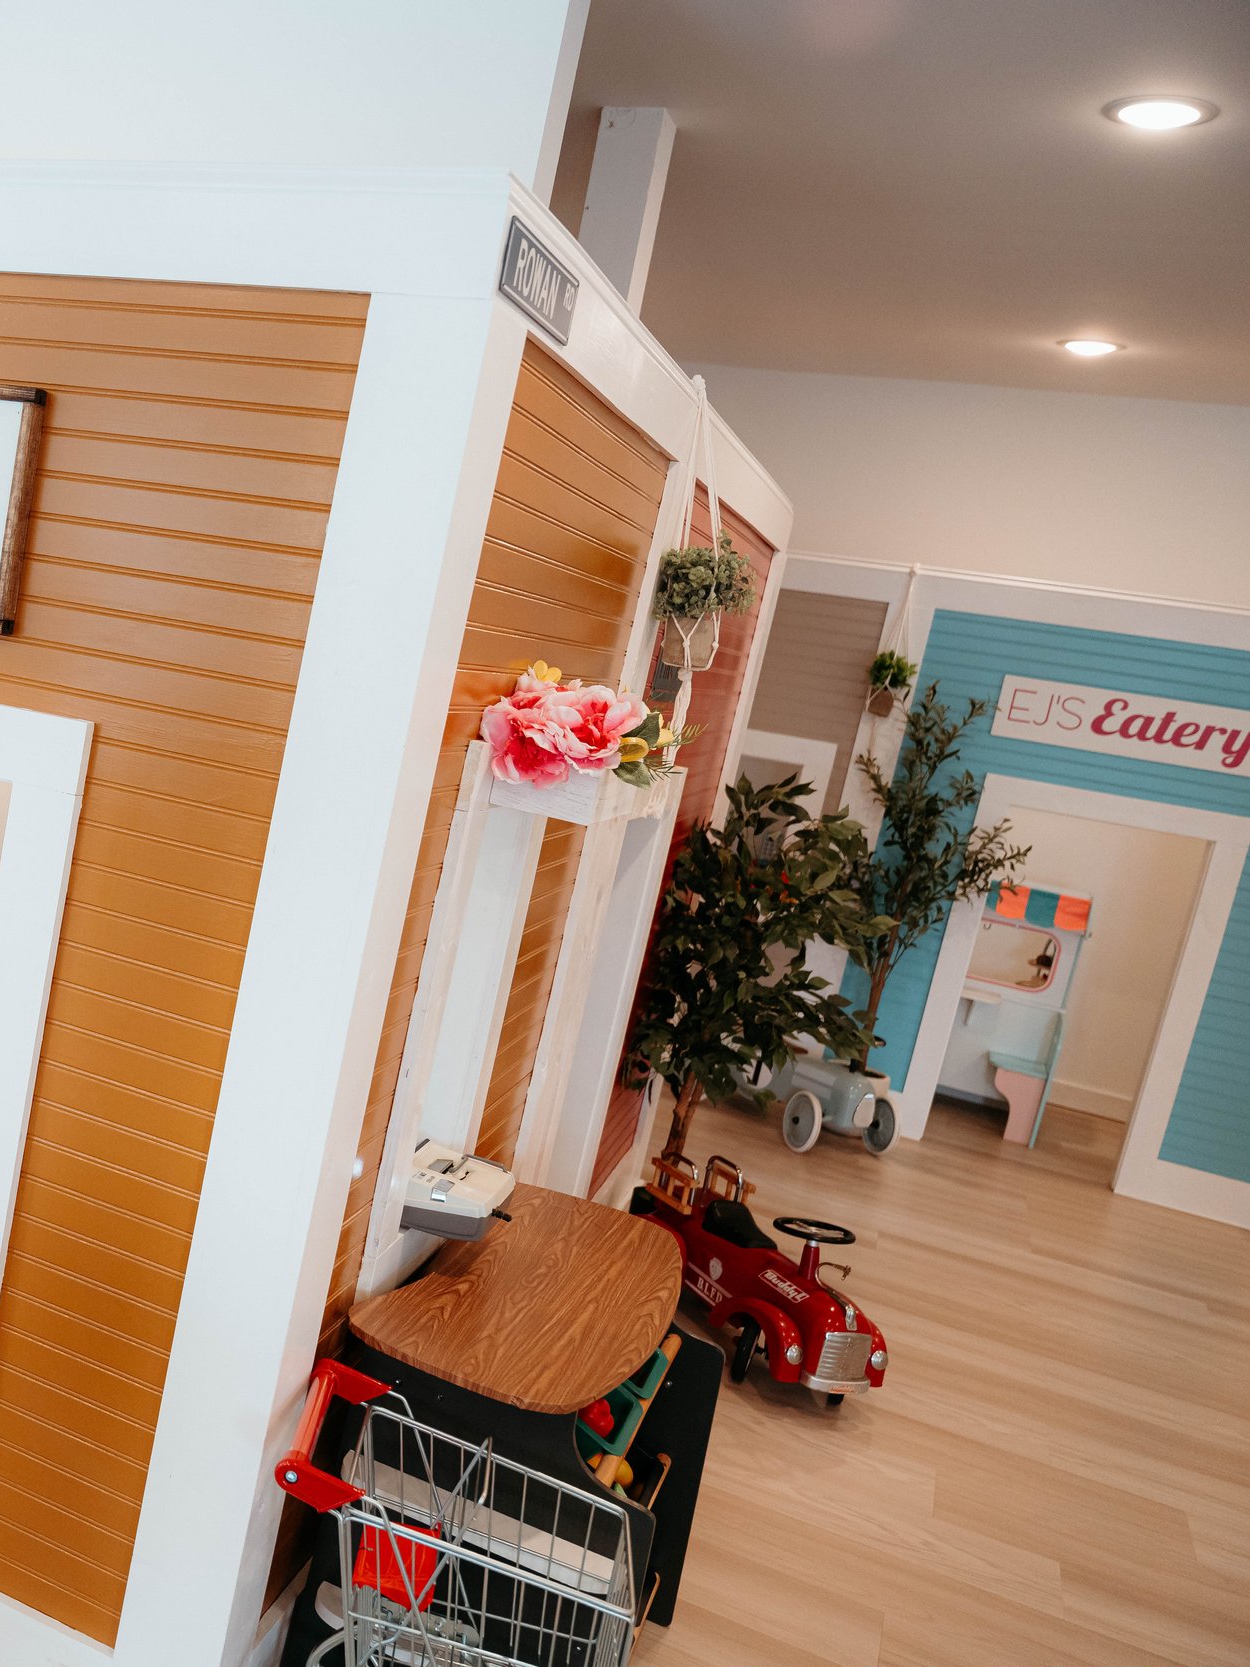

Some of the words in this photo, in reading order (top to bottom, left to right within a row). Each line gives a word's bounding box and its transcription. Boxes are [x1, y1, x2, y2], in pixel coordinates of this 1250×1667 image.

[513, 238, 561, 320] ROWAN
[562, 282, 575, 312] RD
[1007, 688, 1086, 731] EJ'S
[1090, 698, 1250, 769] Eatery
